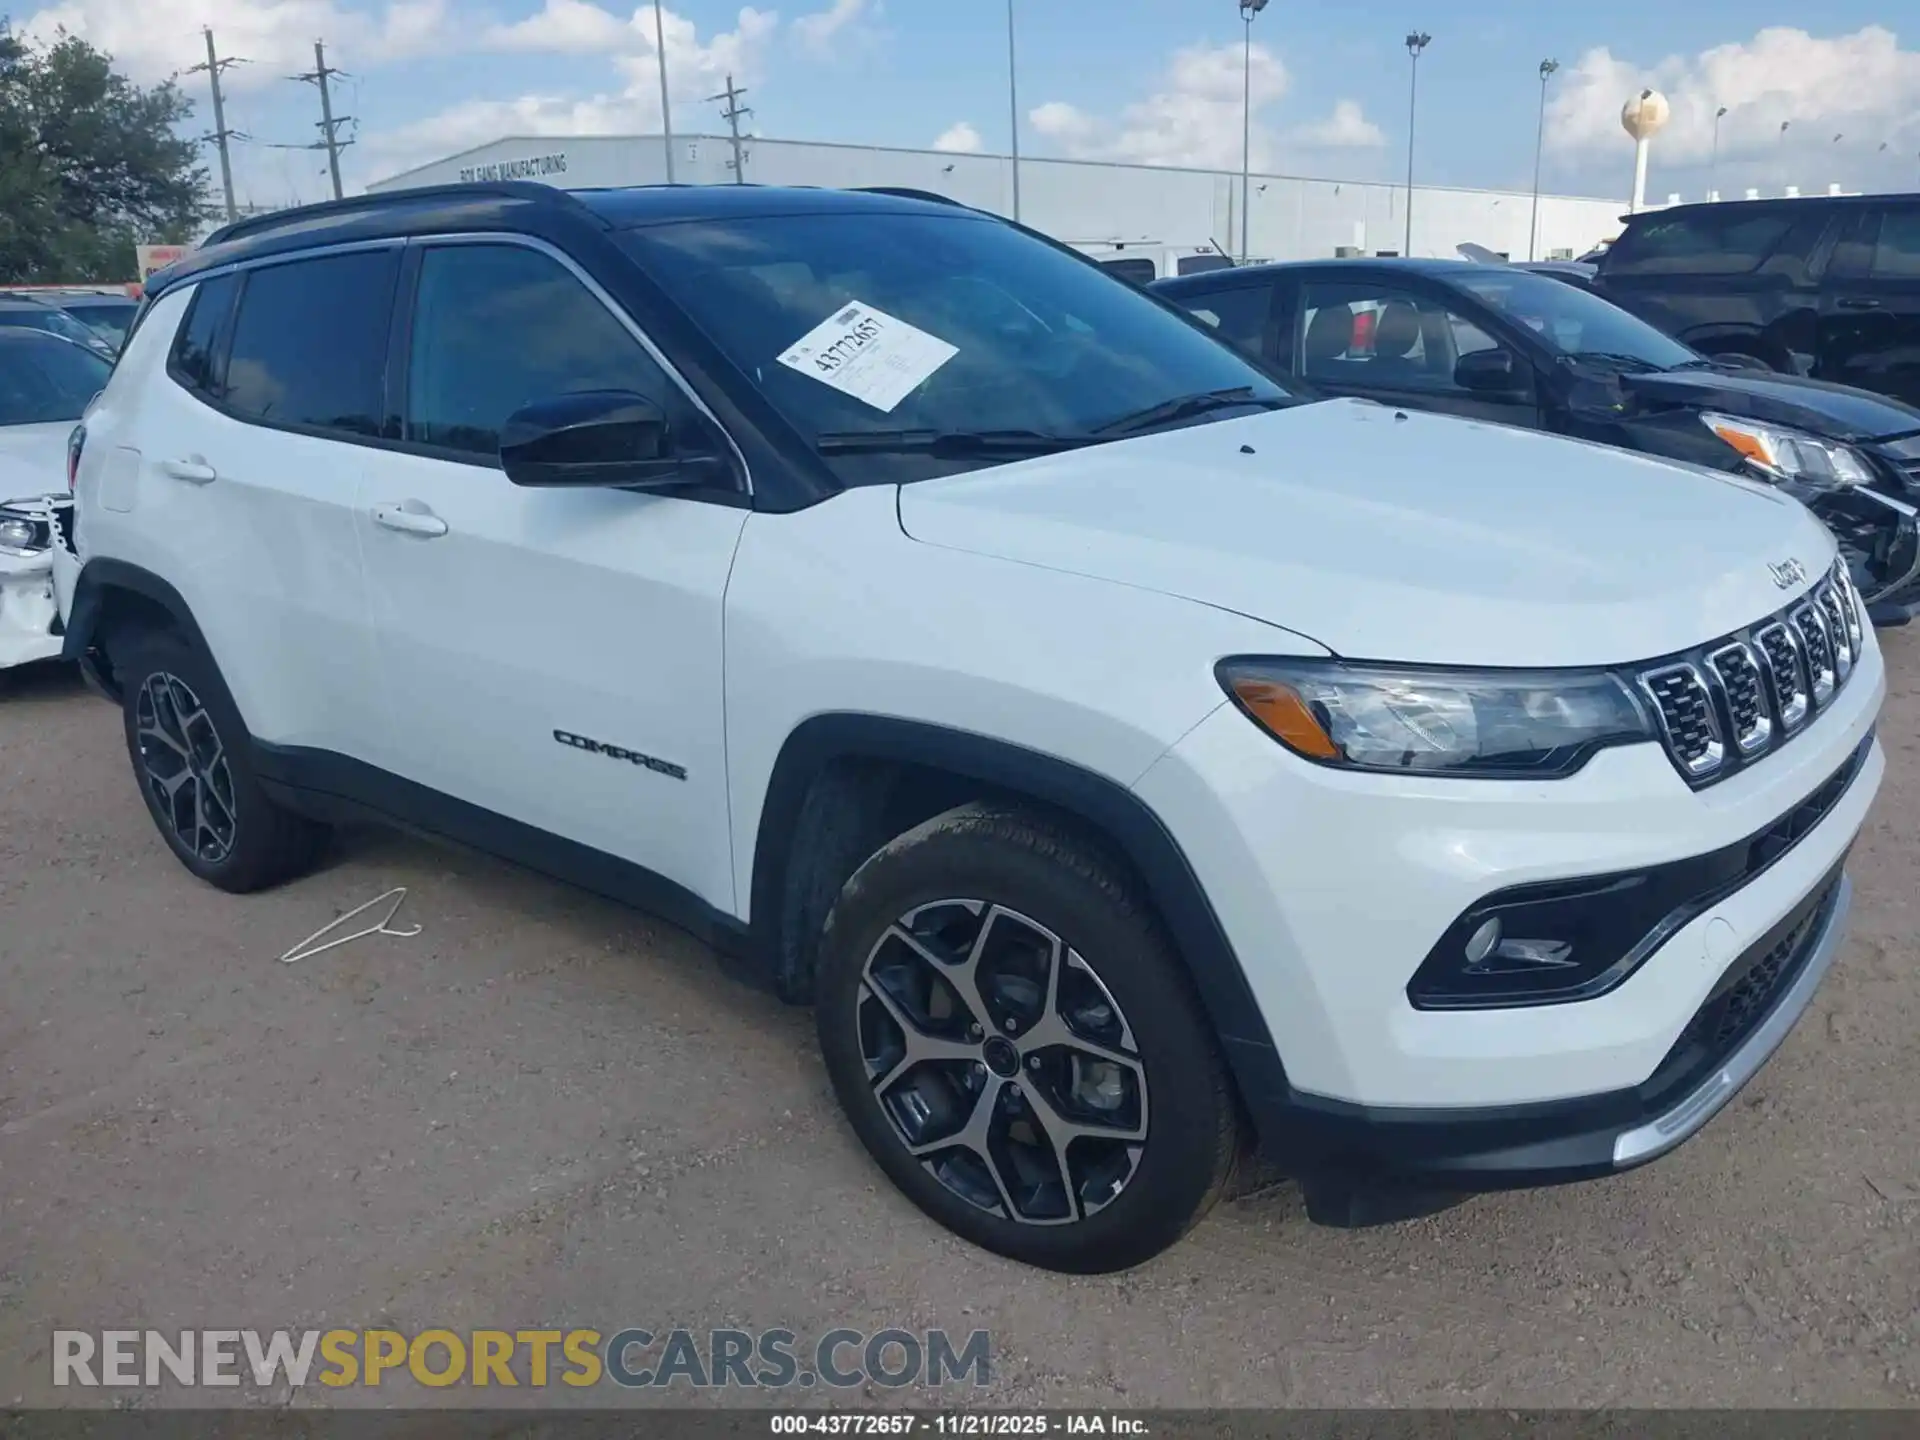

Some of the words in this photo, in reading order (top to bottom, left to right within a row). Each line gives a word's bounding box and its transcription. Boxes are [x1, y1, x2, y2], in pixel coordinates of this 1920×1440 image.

[499, 154, 567, 180] MANUFACTURING
[814, 317, 885, 372] 43772657
[553, 729, 688, 781] COMPASS
